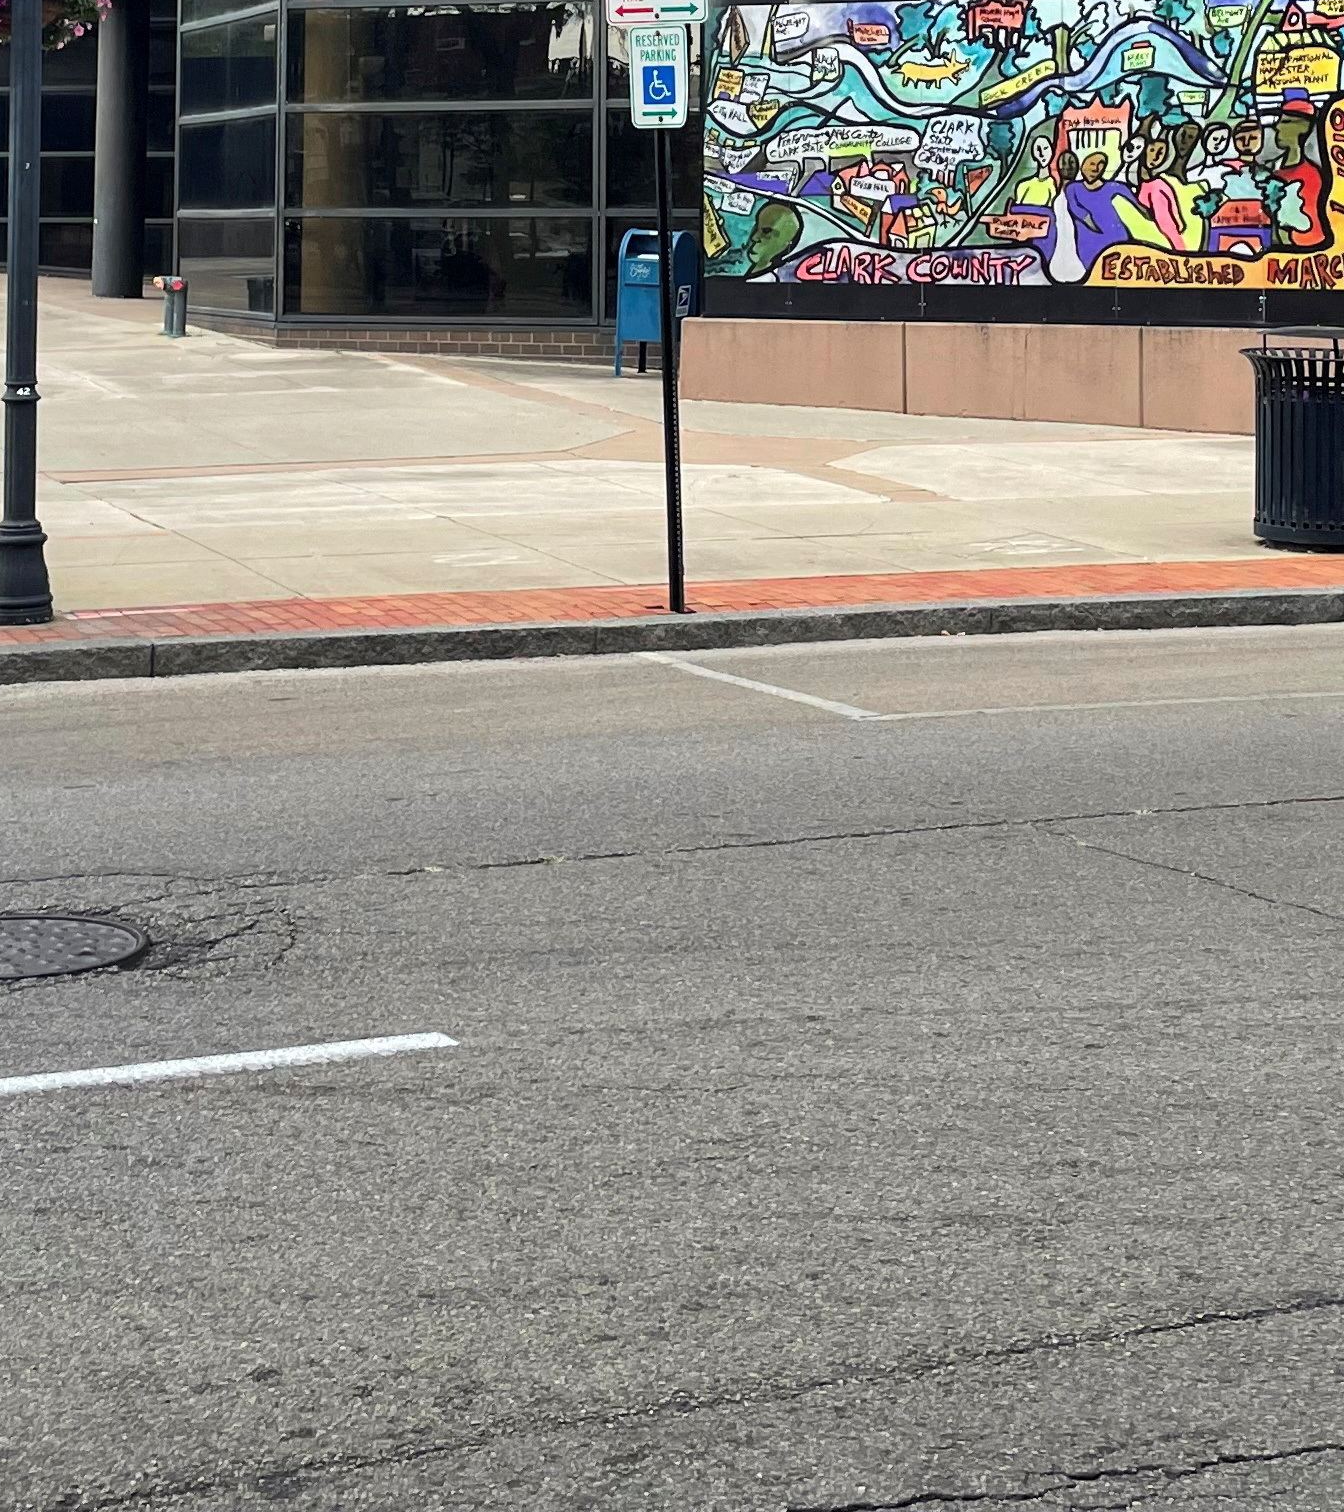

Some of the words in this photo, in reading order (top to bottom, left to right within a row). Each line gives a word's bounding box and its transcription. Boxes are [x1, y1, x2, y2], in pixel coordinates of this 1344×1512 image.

[635, 34, 680, 47] RESERVED
[640, 49, 677, 62] PARKING
[931, 119, 975, 135] CLARK
[796, 246, 902, 284] CLARK
[906, 251, 1037, 286] COUNTY
